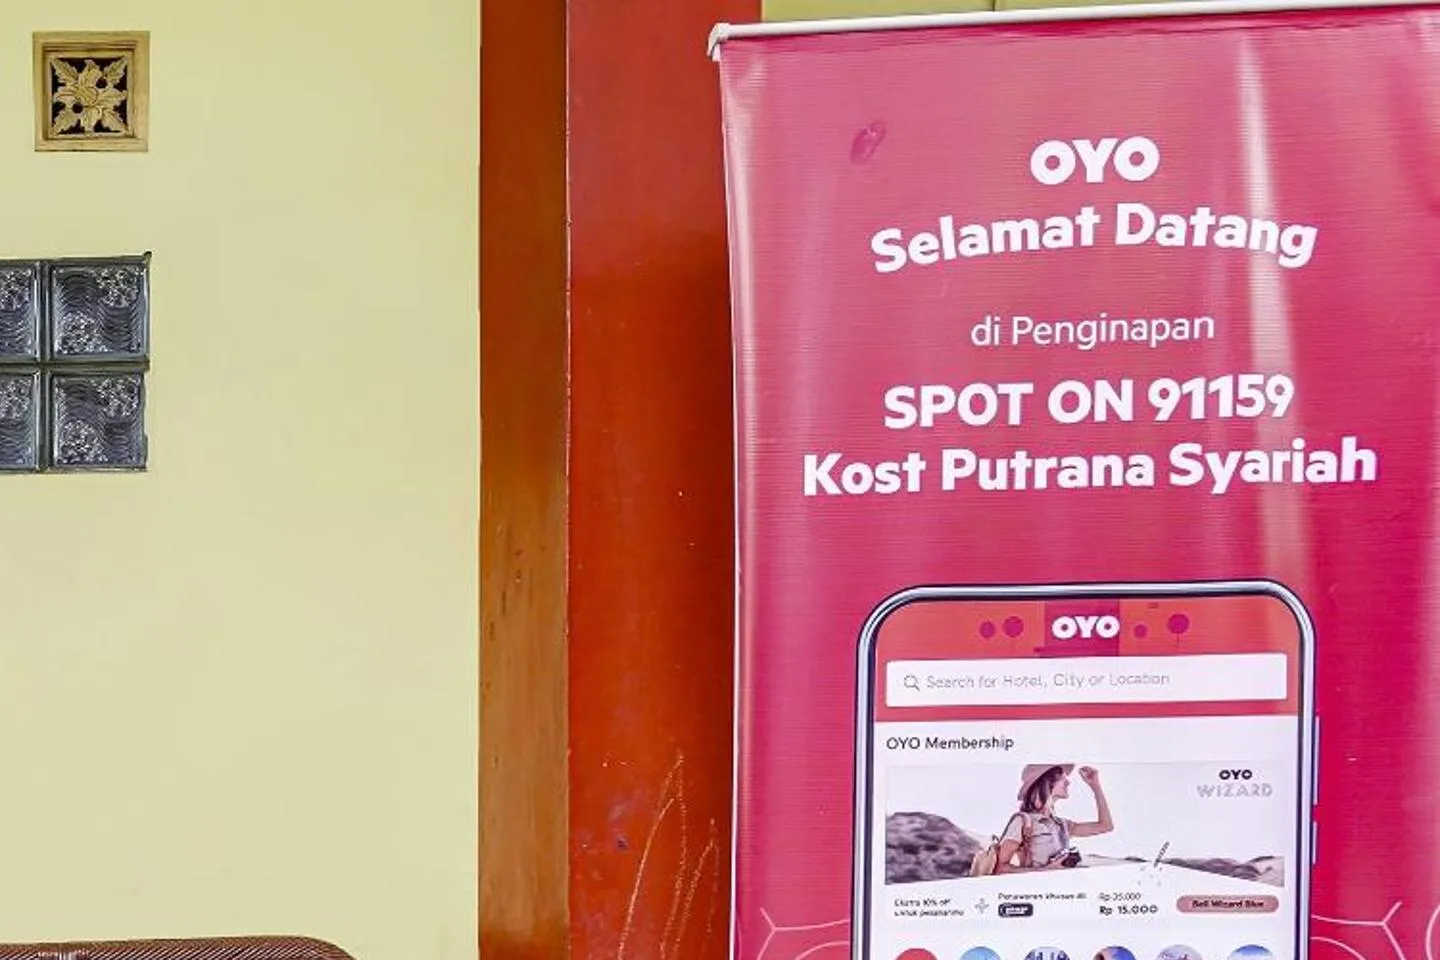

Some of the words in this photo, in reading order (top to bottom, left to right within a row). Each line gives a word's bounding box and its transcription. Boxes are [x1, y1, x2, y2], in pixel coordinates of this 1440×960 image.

[1030, 136, 1160, 185] OYO
[870, 205, 1100, 272] Selamat
[1116, 203, 1317, 268] Datang
[971, 314, 999, 347] di
[1011, 314, 1214, 351] Penginapan
[883, 382, 1033, 429] SPOT
[1047, 379, 1133, 424] ON
[1148, 374, 1293, 421] 91159
[803, 451, 926, 496] Kost
[942, 448, 1155, 491] Putrana
[1169, 436, 1377, 495] Syariah
[1051, 615, 1120, 639] OYO
[927, 675, 974, 689] Search
[978, 674, 997, 688] for
[1053, 673, 1085, 689] City
[1089, 676, 1104, 686] or
[1109, 672, 1170, 686] Location
[886, 737, 921, 750] OYO
[925, 735, 1014, 751] Membership
[1219, 769, 1252, 780] OYO
[1196, 783, 1273, 798] WIZARD
[1099, 906, 1112, 915] Rp
[1117, 905, 1158, 914] 15.000
